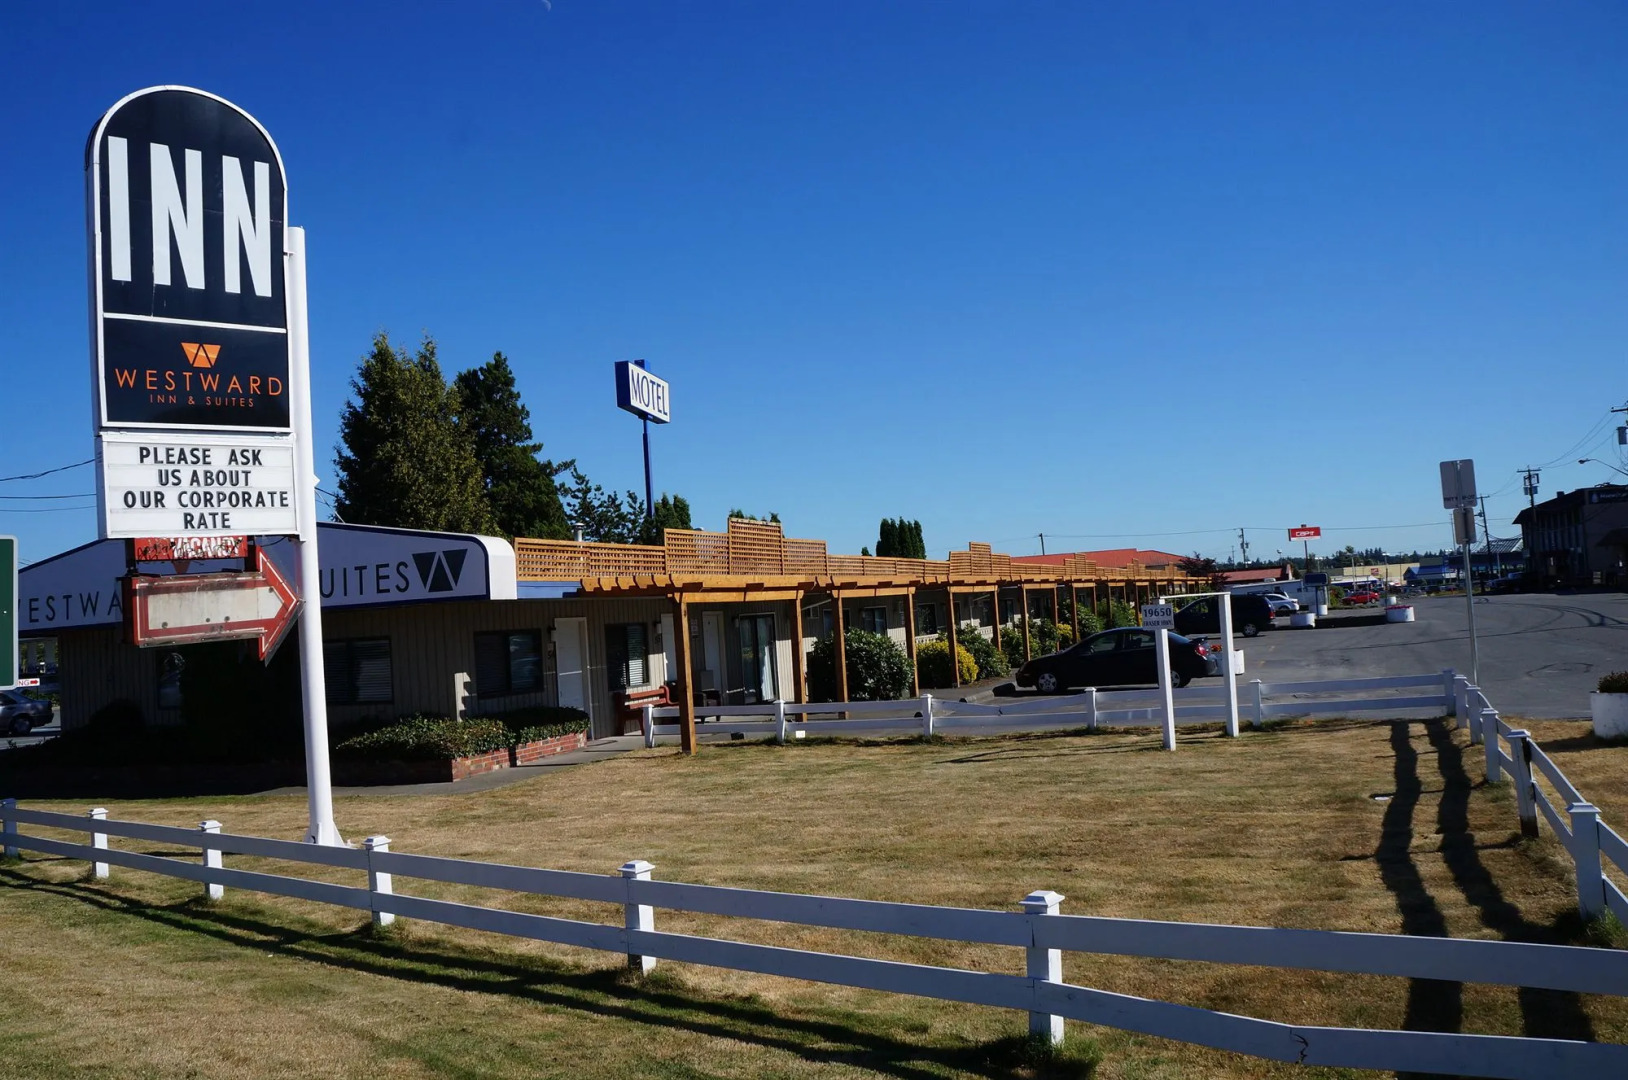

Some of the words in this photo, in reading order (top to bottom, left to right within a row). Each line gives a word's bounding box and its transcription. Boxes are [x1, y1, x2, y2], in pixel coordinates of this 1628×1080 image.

[108, 135, 272, 297] INN
[115, 368, 283, 396] WESTWARD
[150, 394, 177, 404] INN
[188, 395, 196, 405] &
[206, 396, 254, 408] SUITES
[631, 369, 668, 416] MOTEL
[139, 446, 212, 465] PLEASE
[228, 448, 263, 466] ASK
[158, 469, 182, 486] US
[189, 469, 252, 487] ABOUT
[123, 490, 166, 508] OUR
[177, 490, 289, 508] CORPORATE
[183, 512, 231, 529] RATE
[18, 590, 123, 623] ESTWA
[1143, 607, 1172, 617] 19650
